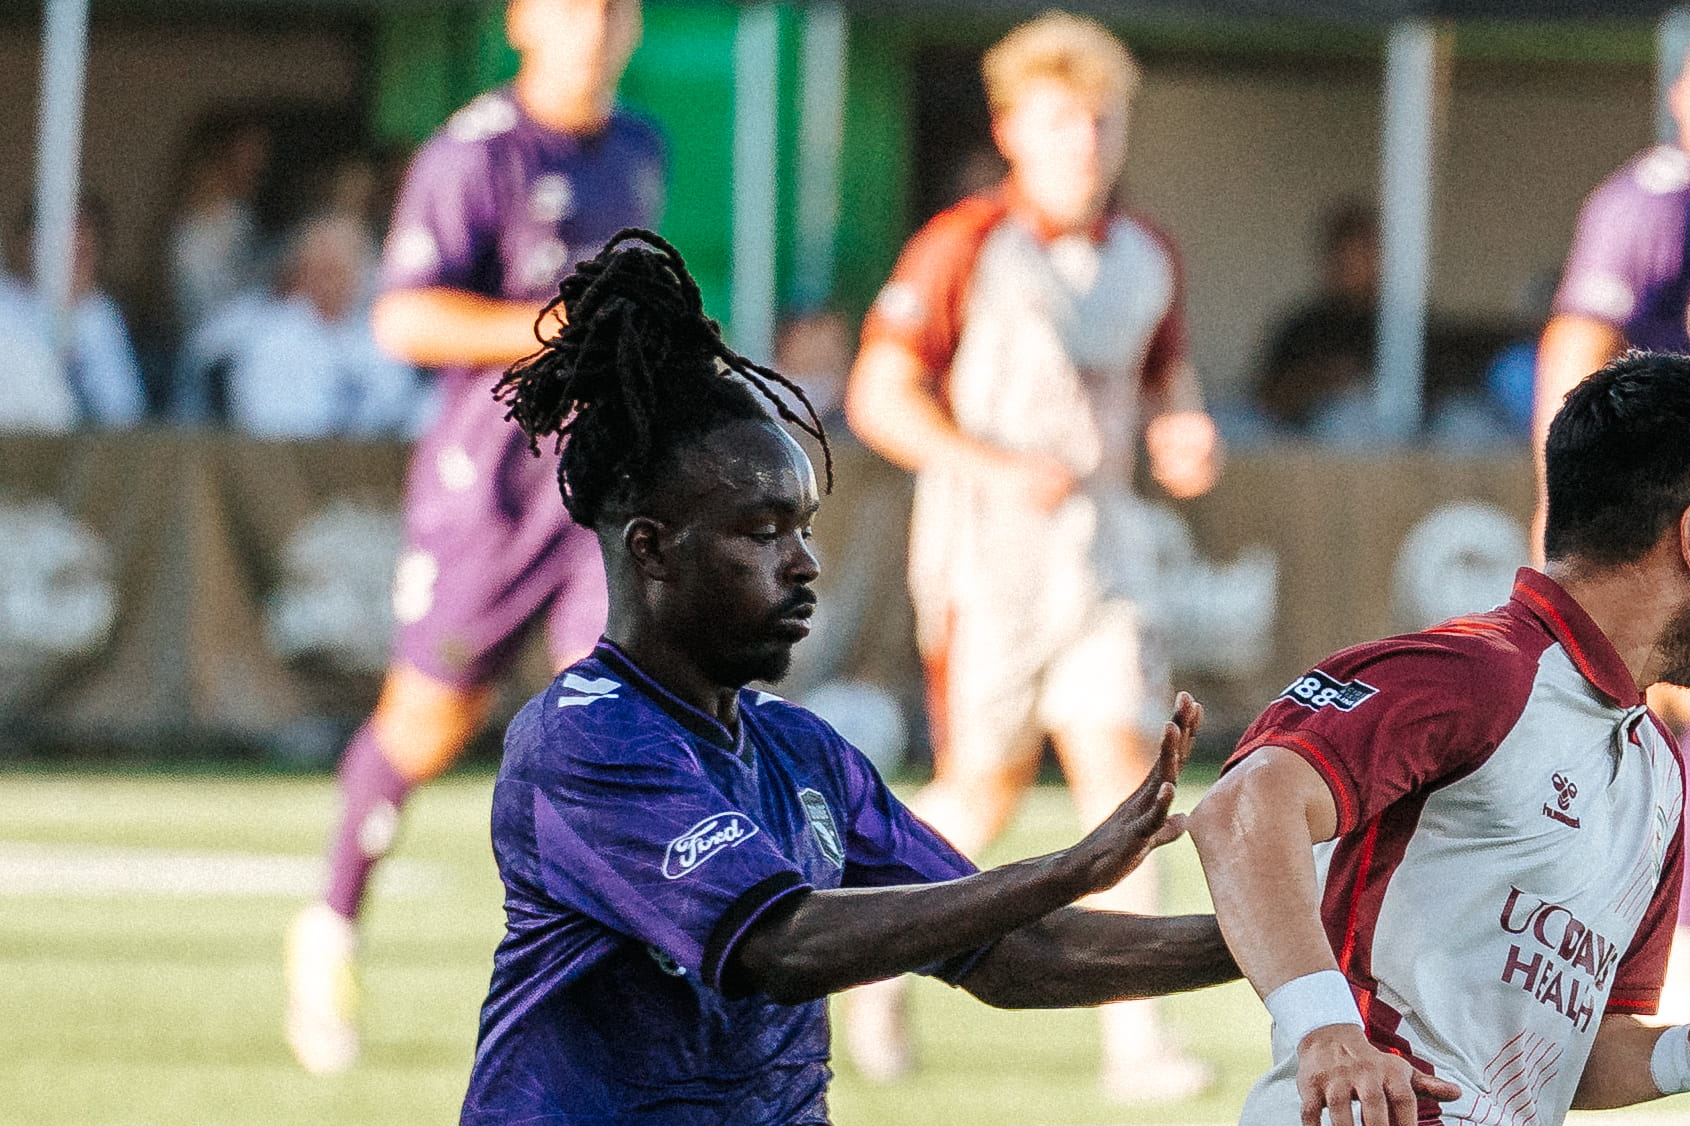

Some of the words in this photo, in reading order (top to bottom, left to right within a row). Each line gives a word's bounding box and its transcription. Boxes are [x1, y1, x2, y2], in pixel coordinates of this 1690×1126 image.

[1280, 676, 1340, 707] 88
[675, 819, 744, 868] Ford
[1500, 944, 1595, 1034] HEALH
